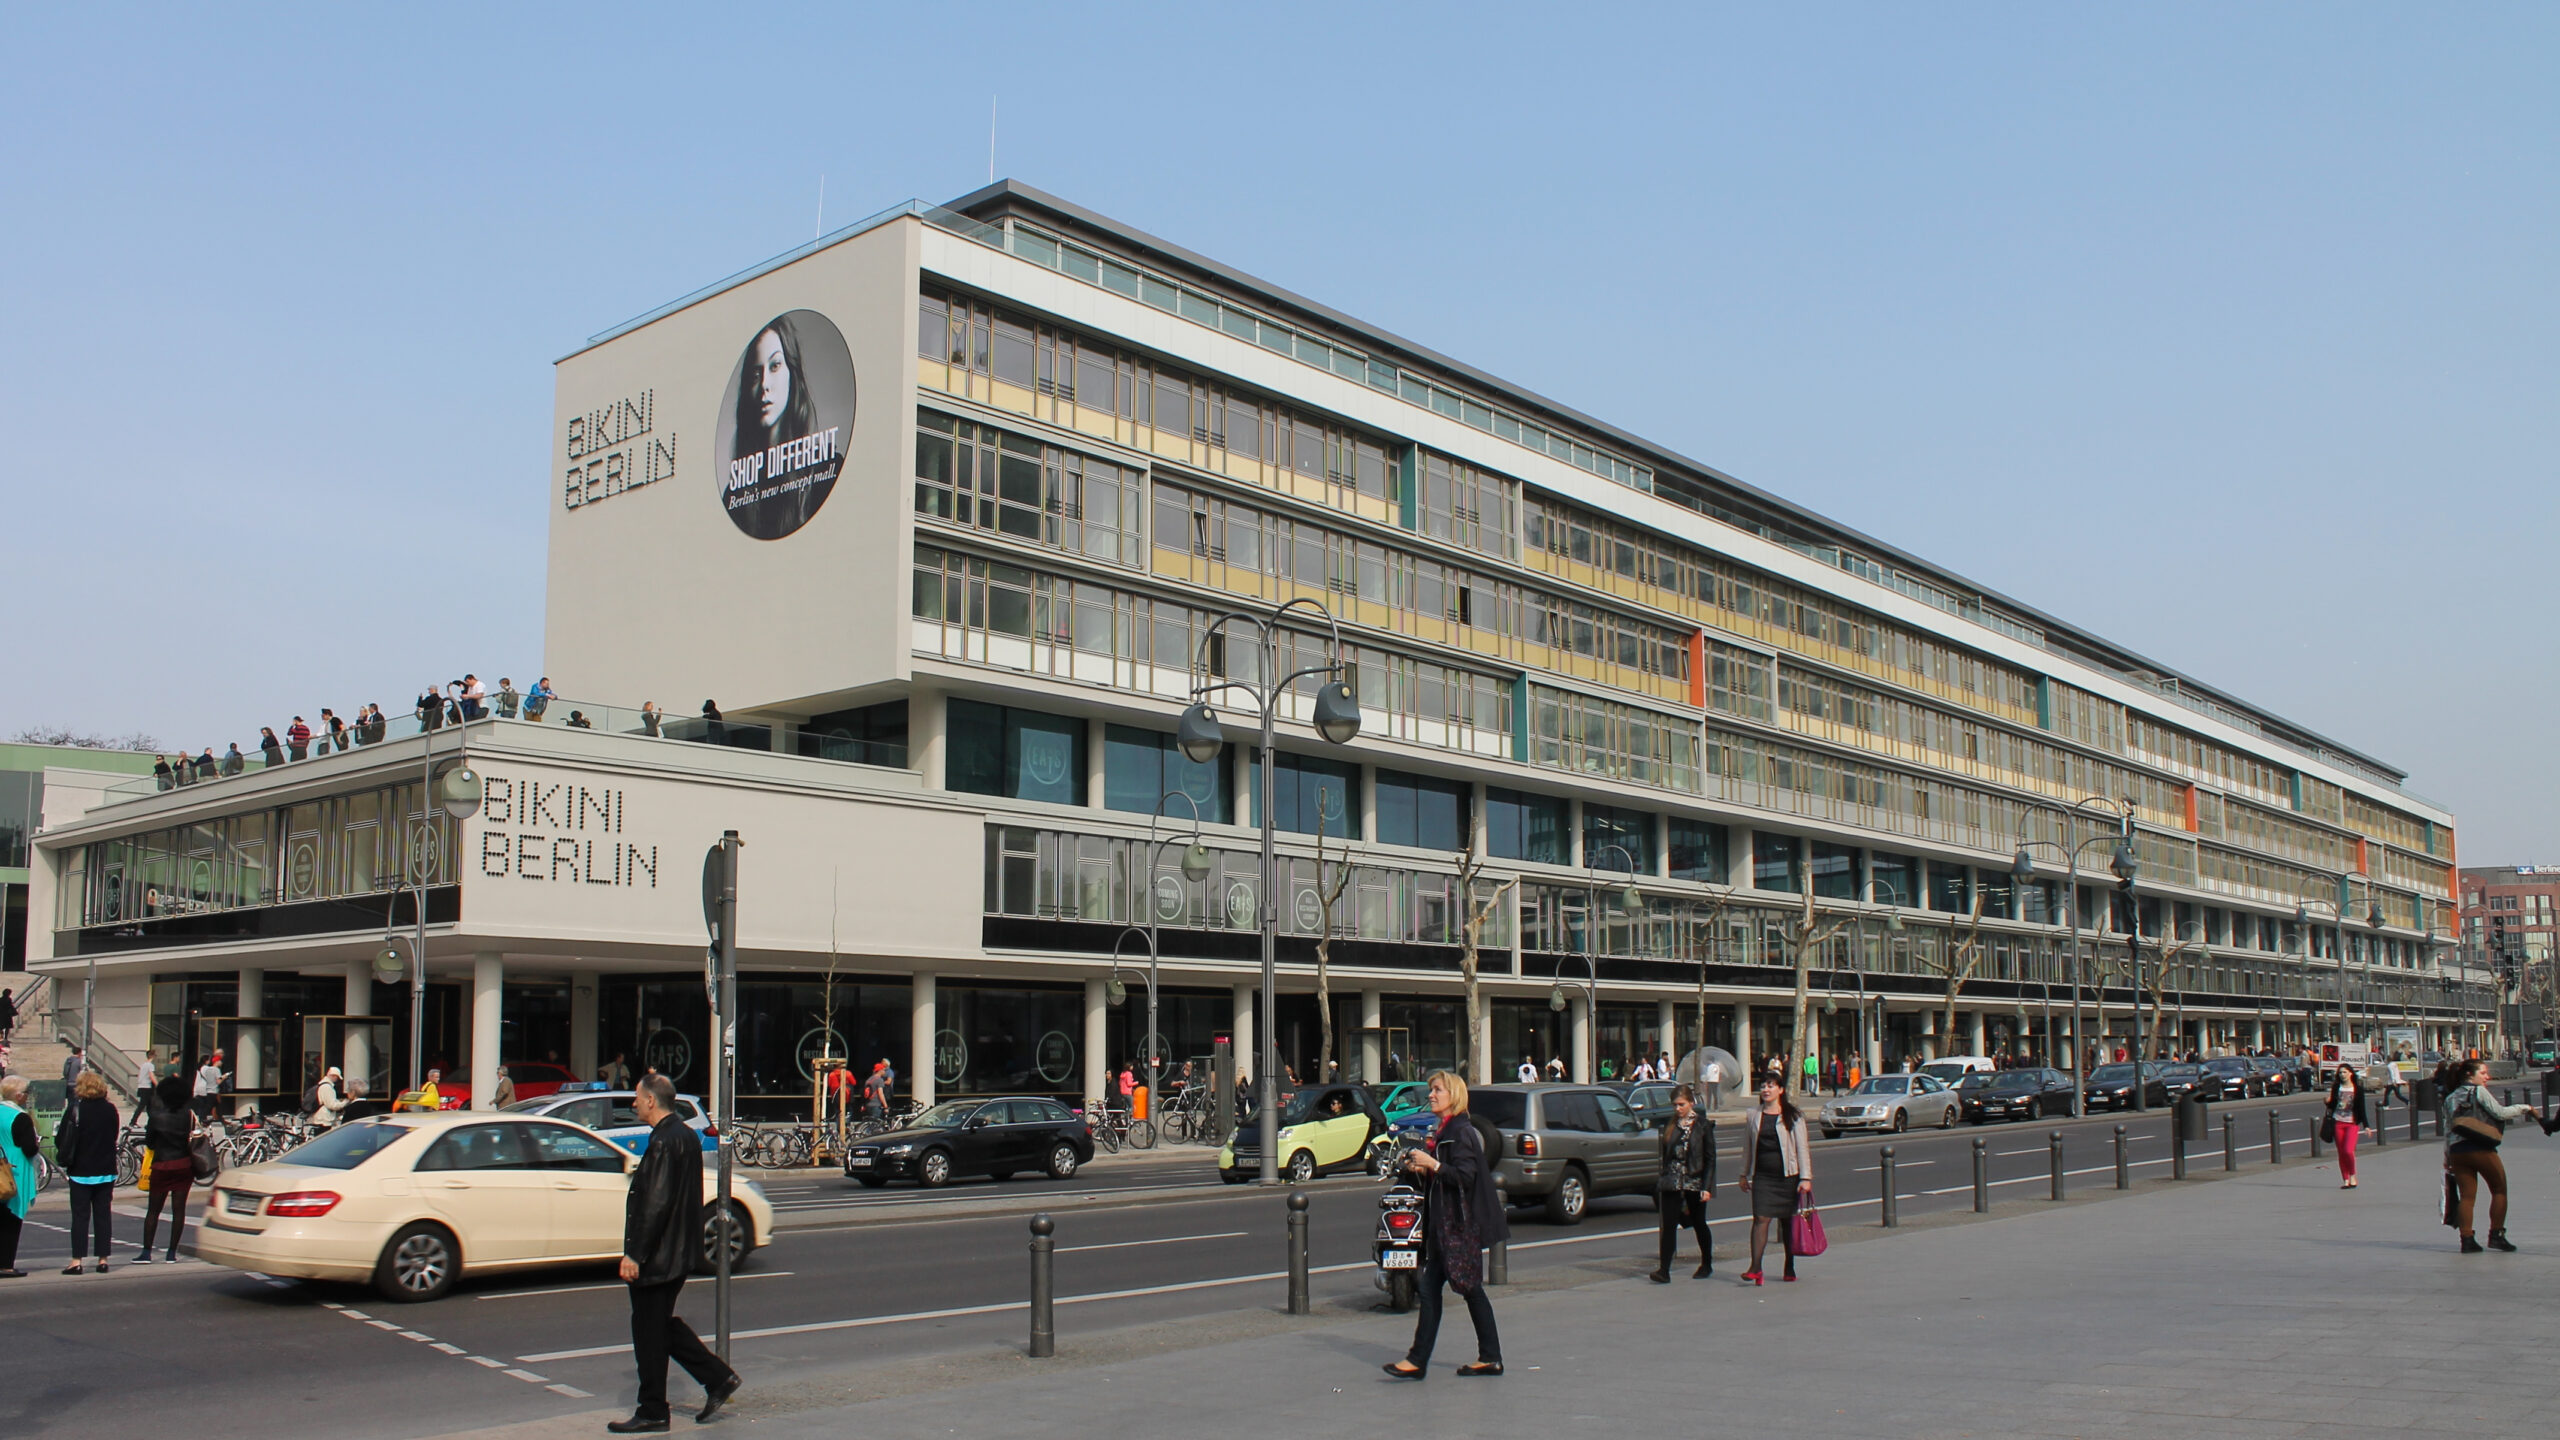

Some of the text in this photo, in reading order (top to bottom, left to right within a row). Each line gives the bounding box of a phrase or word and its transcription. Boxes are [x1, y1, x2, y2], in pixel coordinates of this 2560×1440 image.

[568, 388, 653, 460] BIKINI
[565, 432, 676, 510] BERLIN
[728, 463, 837, 510] Berlin's new concept mall.
[729, 426, 839, 491] SHOP DIFFERENT
[484, 776, 622, 833] BIKINI
[482, 831, 657, 888] BERLIN
[1231, 895, 1254, 919] EATS
